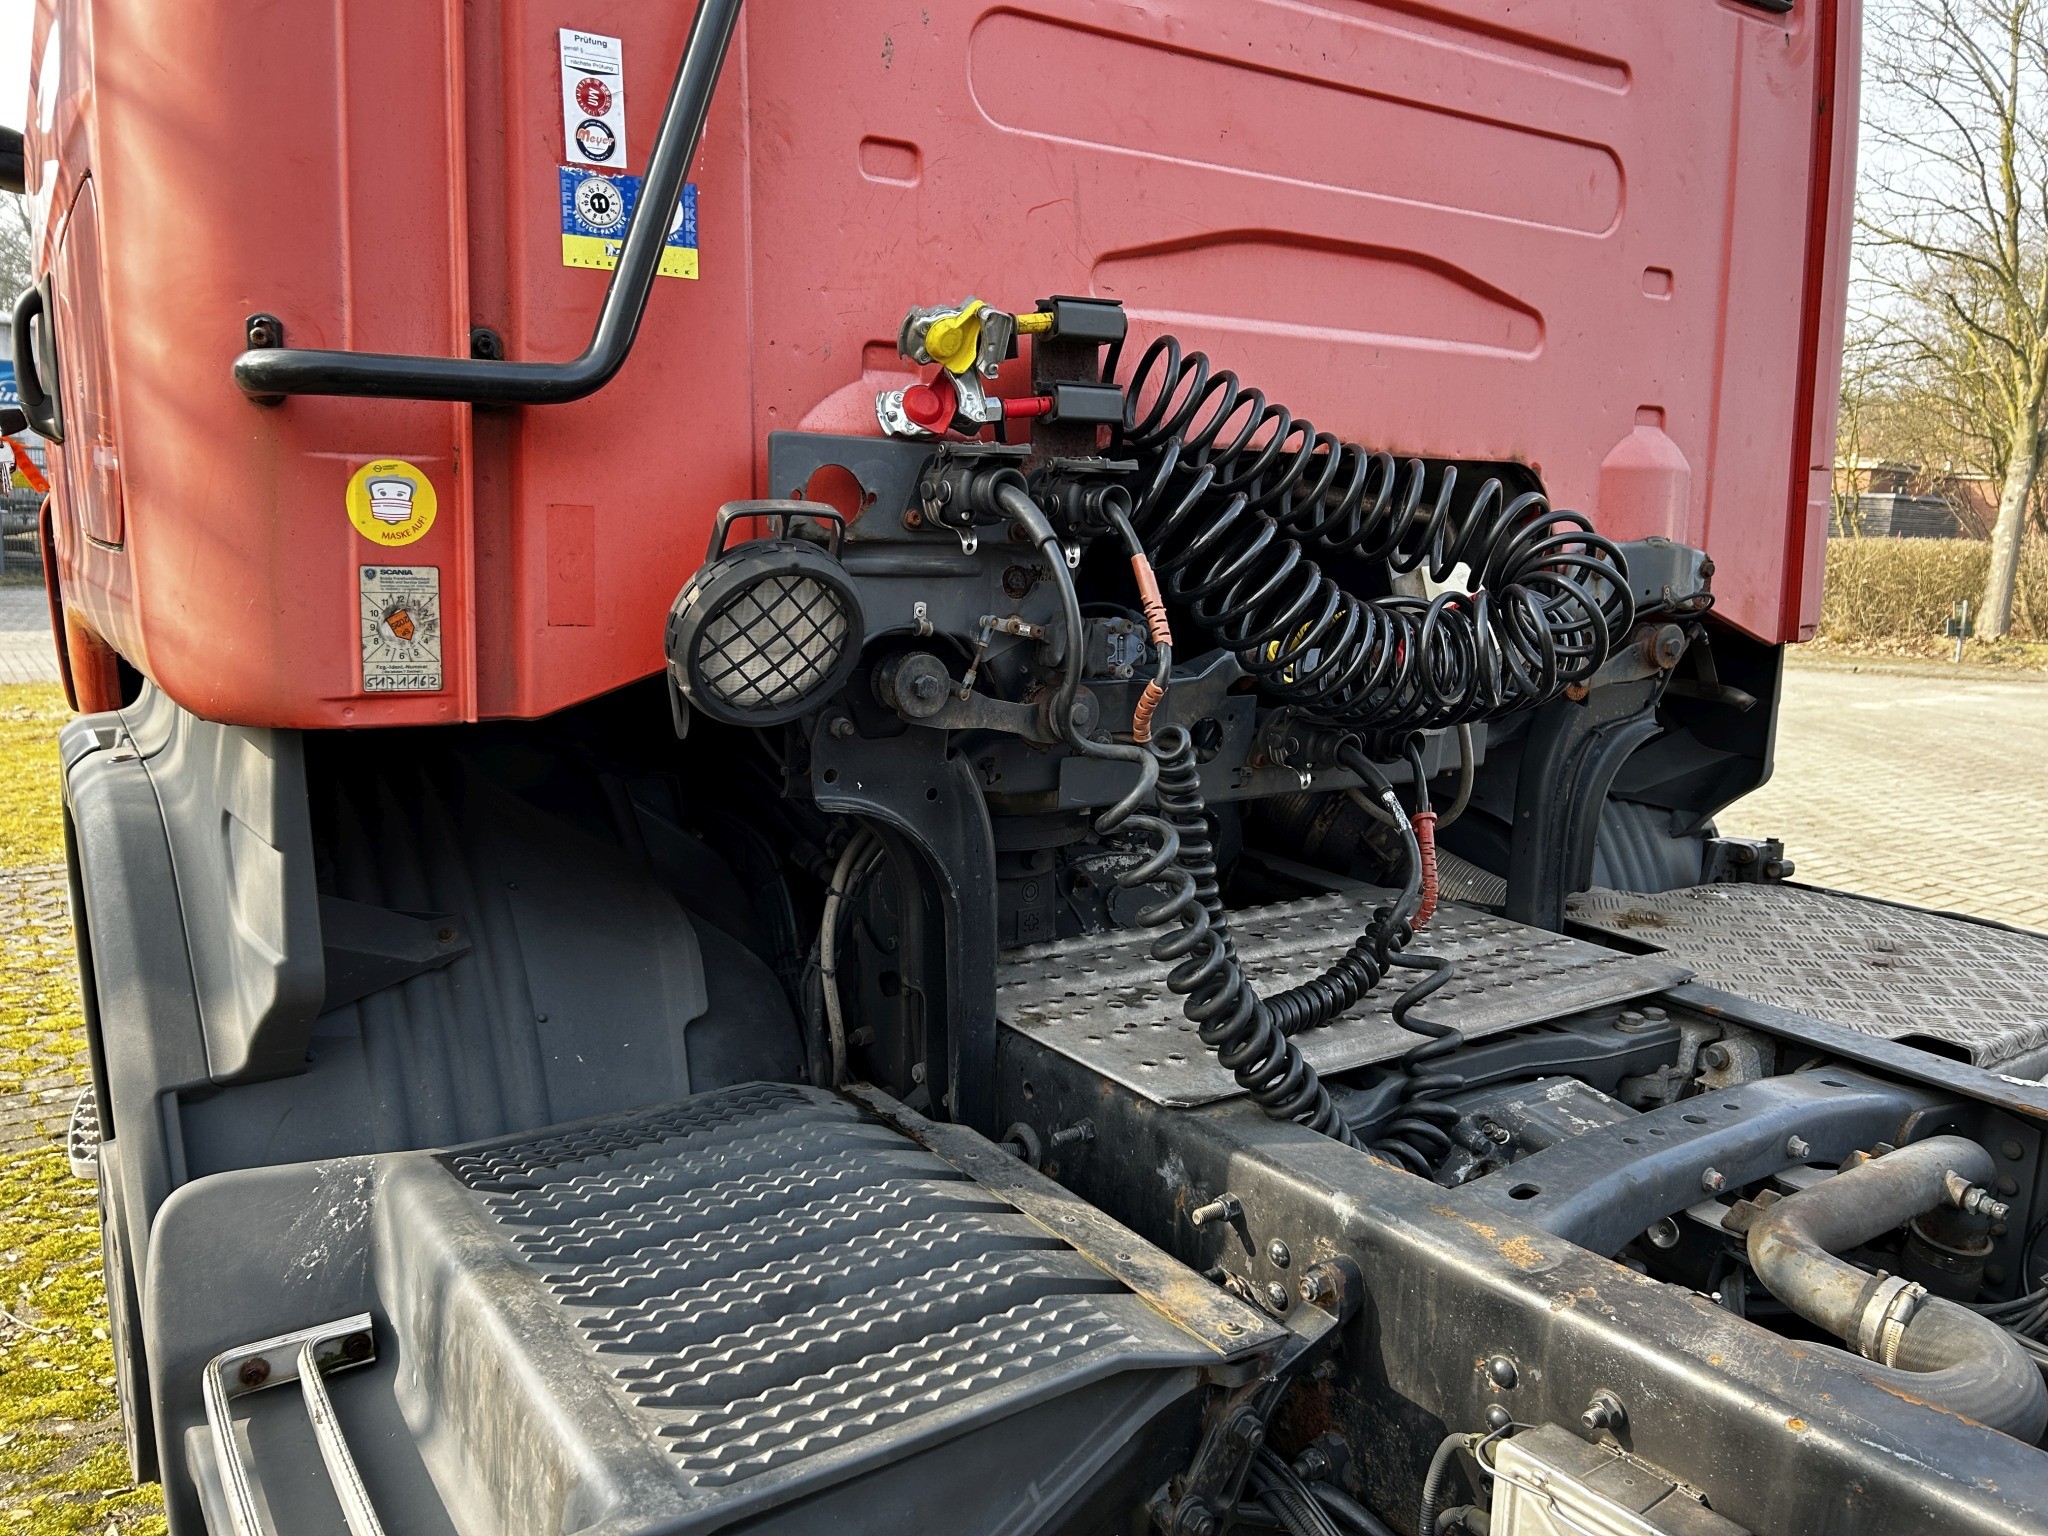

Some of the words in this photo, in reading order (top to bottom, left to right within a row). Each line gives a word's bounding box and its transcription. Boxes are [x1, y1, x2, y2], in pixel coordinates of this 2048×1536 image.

[574, 35, 608, 48] Prüfung
[593, 63, 613, 72] Prüfung
[588, 87, 600, 106] UVV
[576, 128, 615, 146] Meyer
[592, 198, 606, 209] 11
[382, 529, 412, 540] MASKE
[411, 515, 428, 533] AUF!
[373, 637, 379, 645] 8
[399, 652, 405, 660] 6
